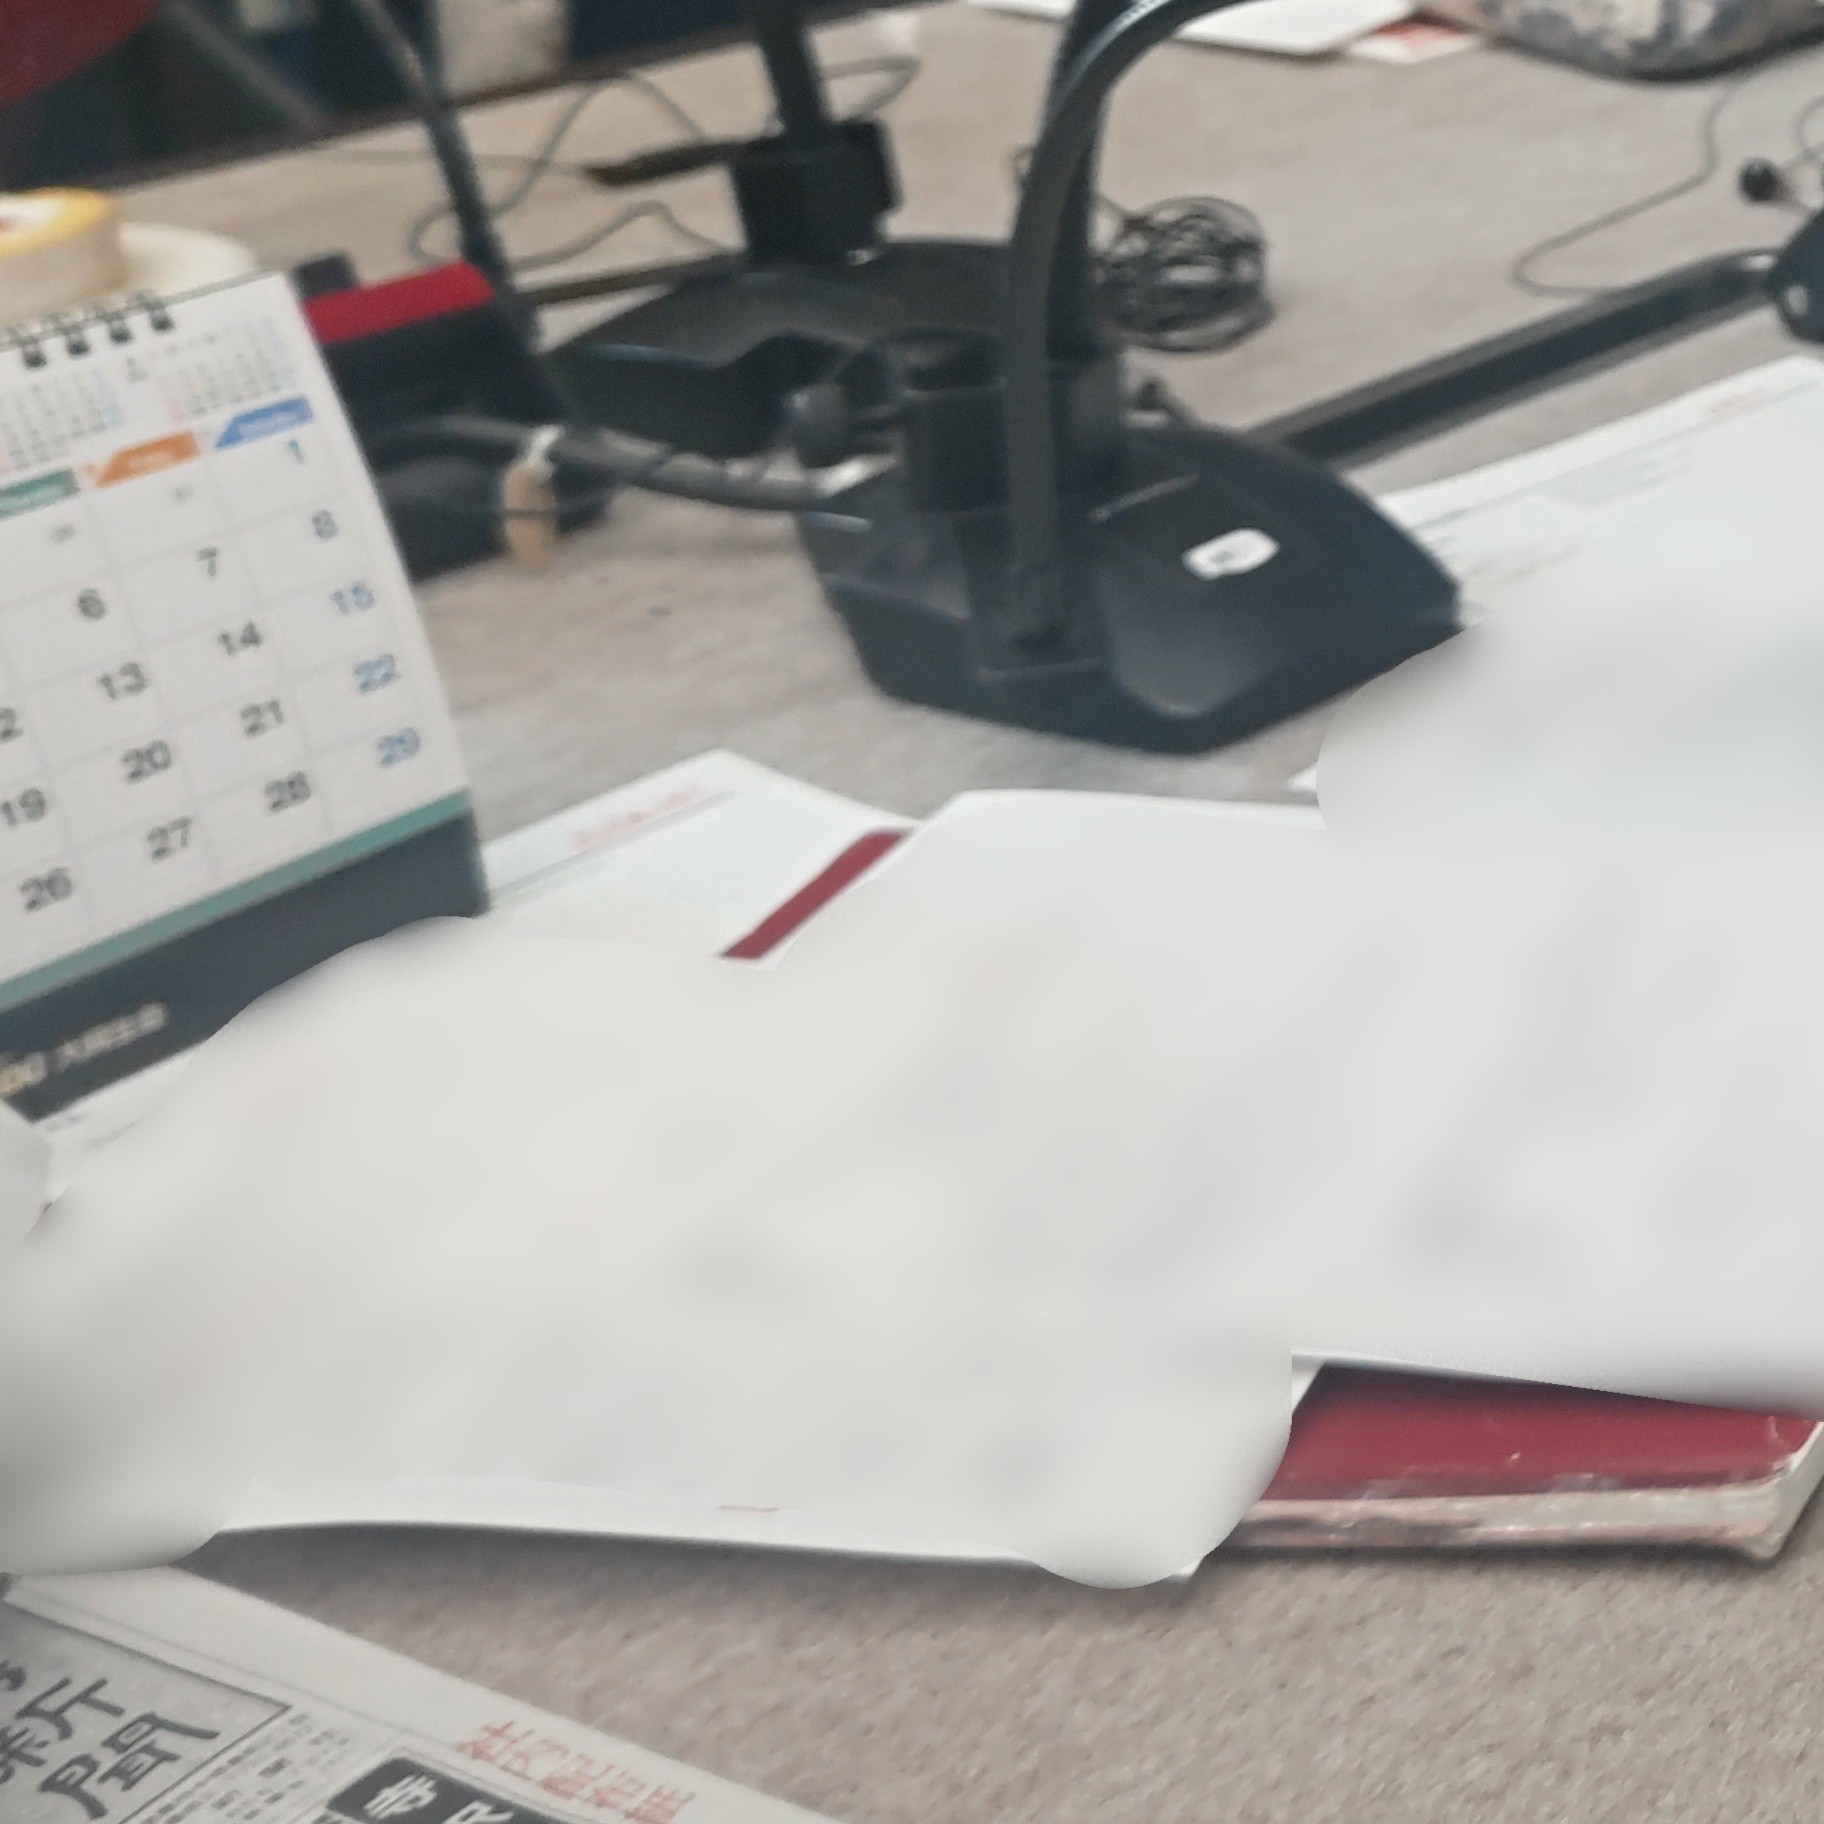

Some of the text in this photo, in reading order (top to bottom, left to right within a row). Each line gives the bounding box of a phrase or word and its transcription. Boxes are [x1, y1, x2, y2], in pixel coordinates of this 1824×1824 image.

[77, 509, 339, 620] 6 7 8
[0, 579, 374, 743] 2 13 14 15
[0, 653, 397, 827] 19 20 21 22
[19, 727, 421, 913] 26 27 28 29
[0, 1660, 220, 1821] 新聞
